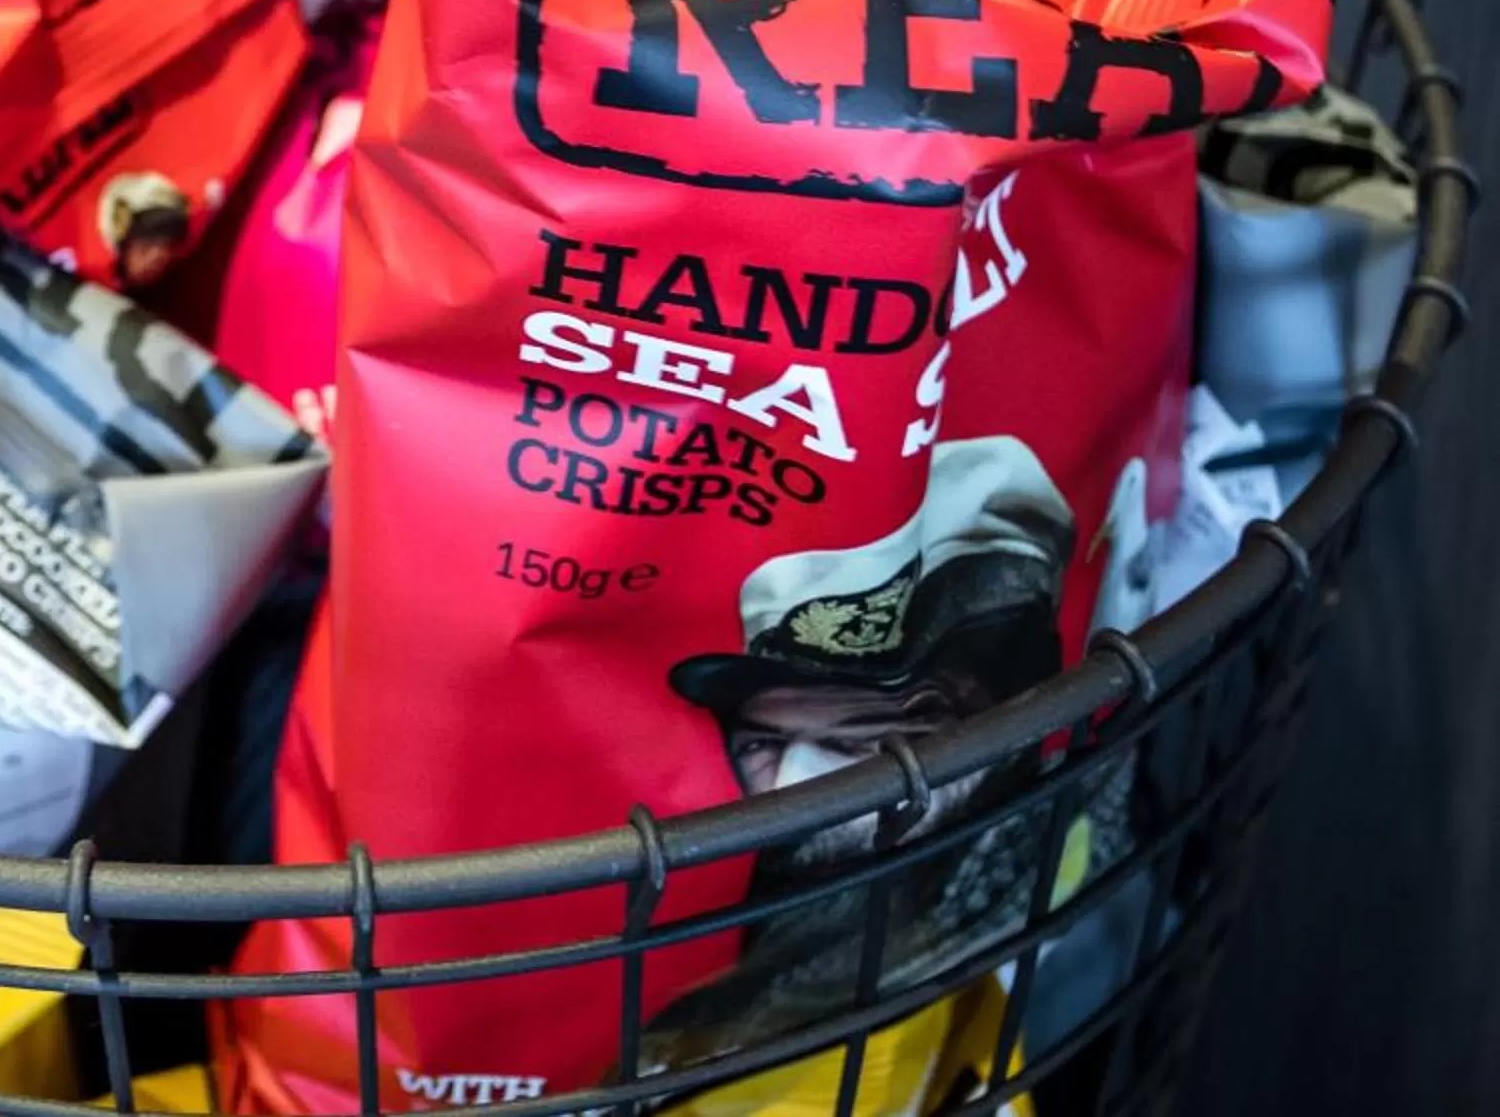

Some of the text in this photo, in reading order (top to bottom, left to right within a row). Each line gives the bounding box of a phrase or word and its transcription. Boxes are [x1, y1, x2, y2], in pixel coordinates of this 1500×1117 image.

[519, 310, 858, 463] SEA
[507, 438, 780, 527] CRISPS
[513, 376, 827, 505] POTATO
[495, 542, 612, 600] 150g
[395, 1067, 548, 1106] WITH
